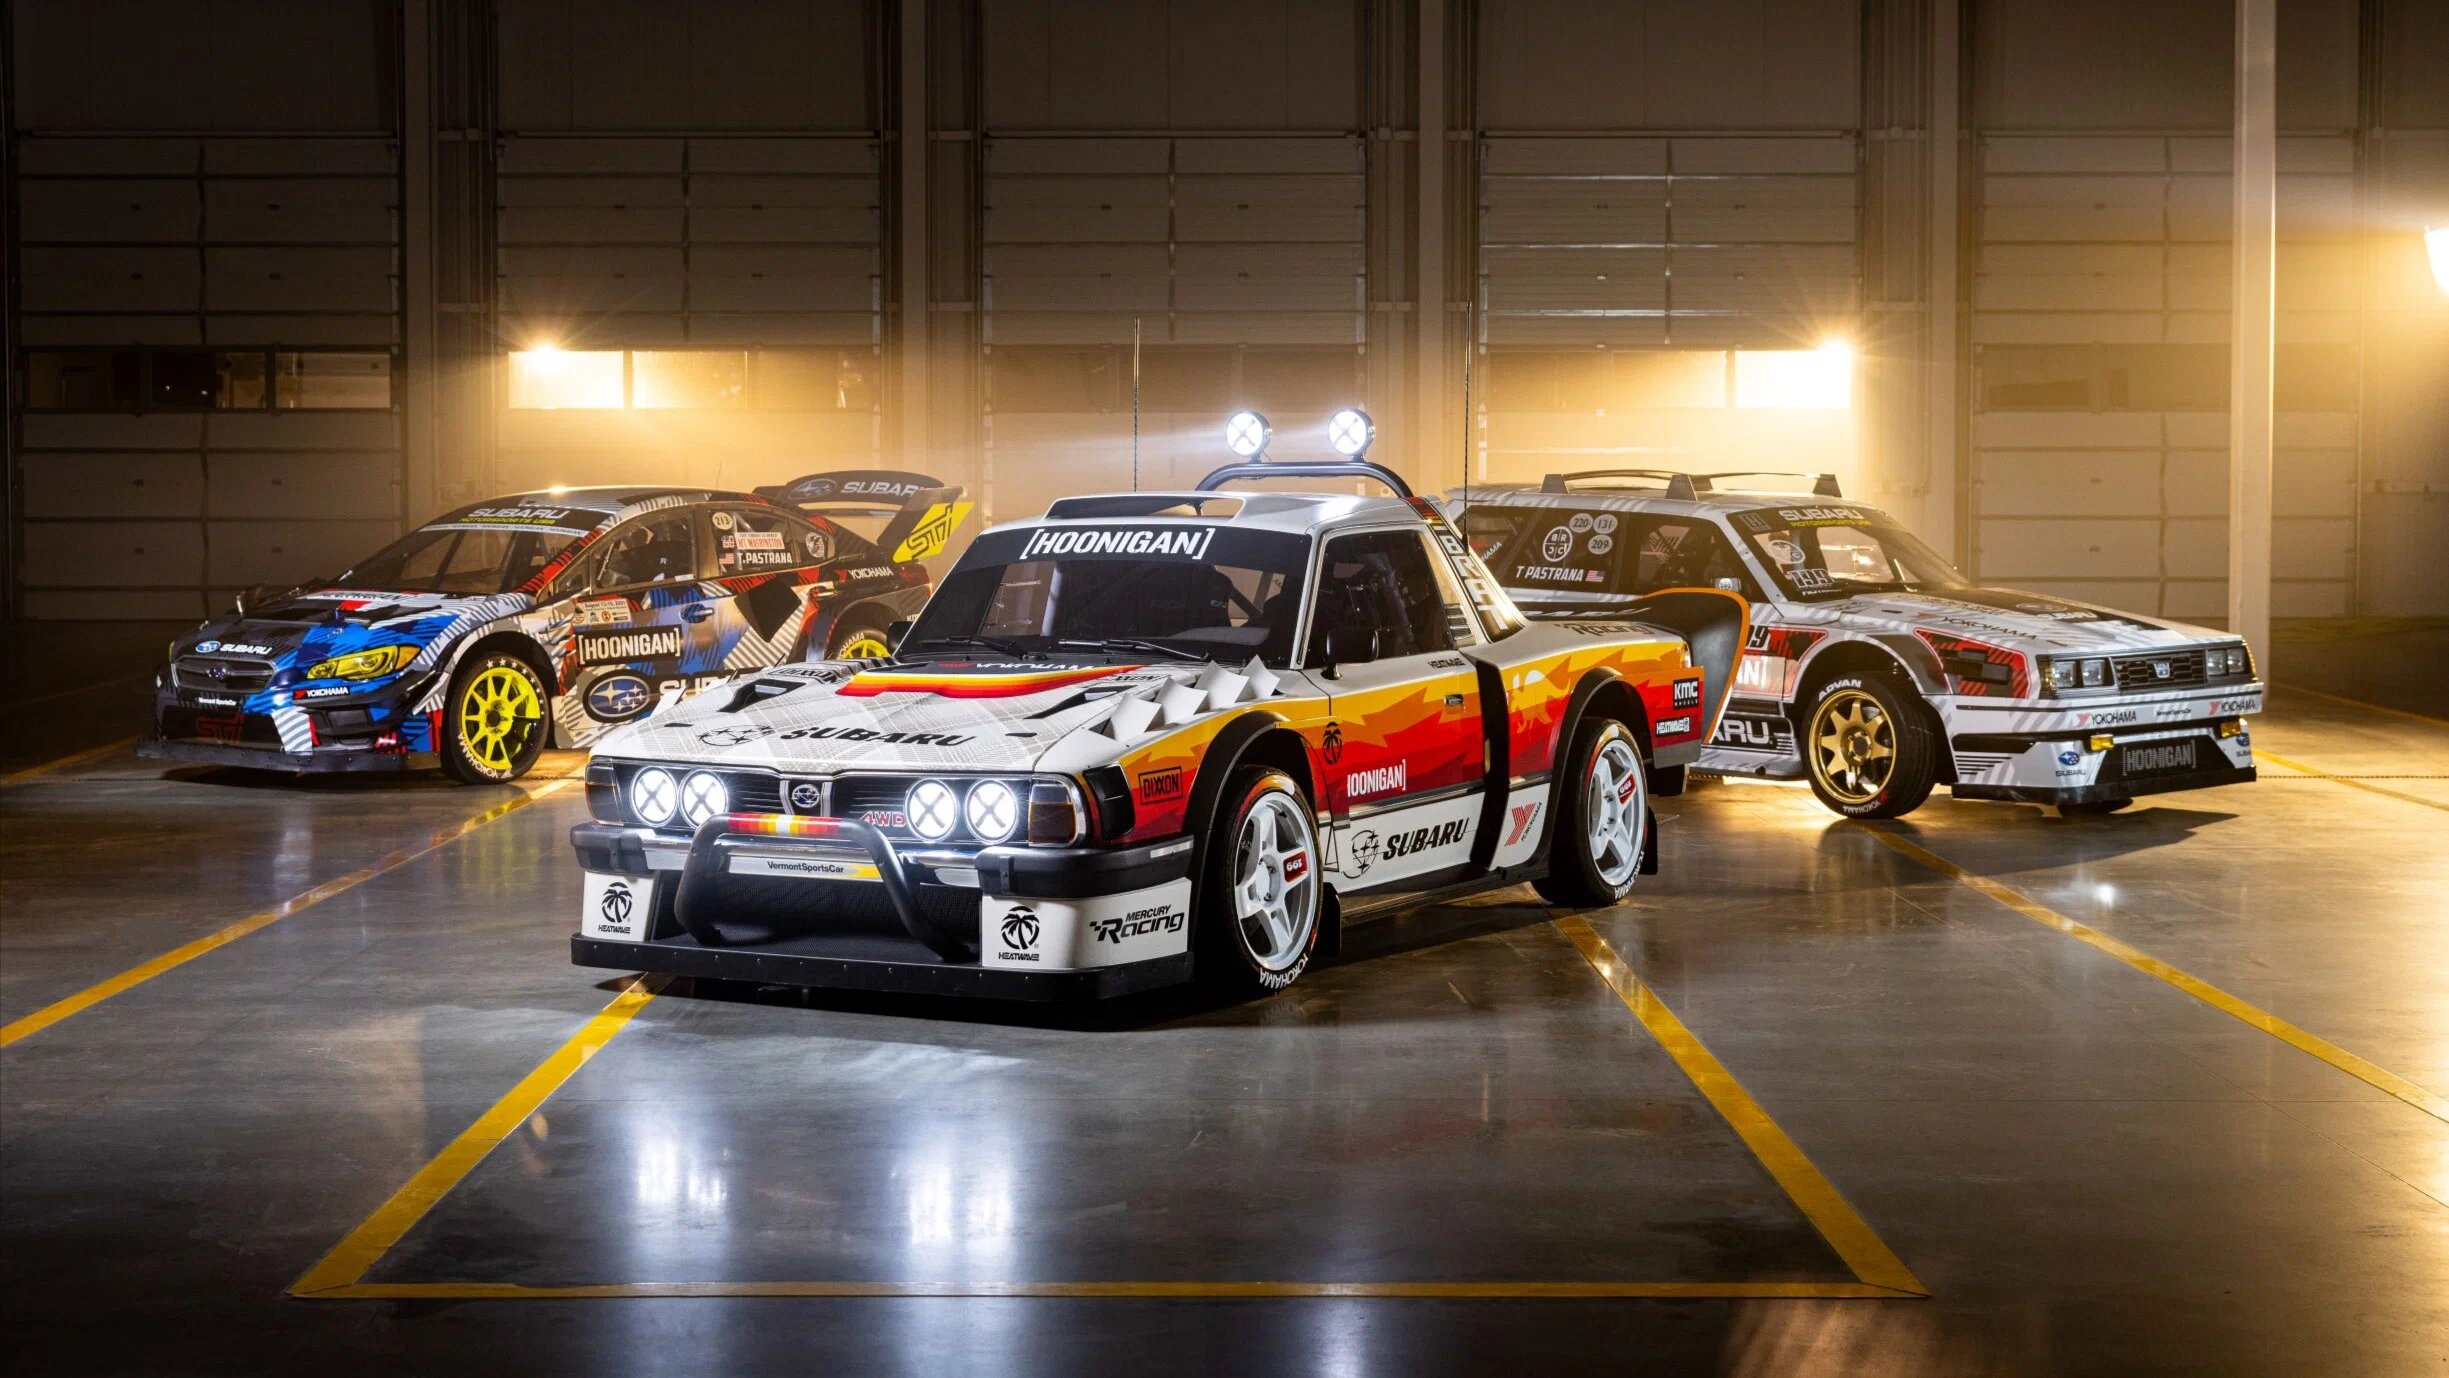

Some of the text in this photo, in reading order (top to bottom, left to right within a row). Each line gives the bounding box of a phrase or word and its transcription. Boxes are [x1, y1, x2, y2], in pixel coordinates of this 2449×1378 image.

[841, 481, 919, 497] SUBAR
[468, 508, 571, 519] SUBARU
[1778, 509, 1864, 520] SUBARU
[906, 503, 953, 560] STI
[1573, 518, 1589, 528] 220
[1598, 519, 1613, 529] 131
[1019, 528, 1216, 560] [HOONIGAN]
[1483, 541, 1502, 561] HAMA
[1592, 540, 1609, 549] 209
[848, 566, 894, 580] YOKOHAMA
[1516, 566, 1584, 582] T PASTRANA
[1786, 568, 1835, 588] 199
[1438, 534, 1508, 631] BRAT
[220, 643, 273, 655] SUBARU
[578, 627, 681, 665] [HOONIGAN]
[306, 687, 349, 697] YOKOHAMA
[1674, 681, 1698, 700] KMC
[1818, 679, 1862, 701] ADVAN
[2220, 699, 2256, 713] YOKOHAMA
[2091, 710, 2137, 725] YOKOHAMA
[780, 727, 977, 746] SUBARU
[1712, 719, 1770, 744] ARU
[458, 732, 498, 779] YOKOHAMA
[2121, 740, 2197, 776] [HOONIGAN]
[1347, 759, 1407, 798] OONIGAN]
[2055, 769, 2087, 777] SUBARU
[1143, 773, 1179, 798] DIXXON
[1842, 800, 1881, 815] YOKOHAMA
[860, 811, 906, 828] 4WD
[1382, 817, 1470, 861] SUBARU
[767, 860, 845, 874] VermontSportsCar
[1286, 857, 1302, 872] 199
[1125, 904, 1171, 923] MERCURY
[598, 924, 631, 934] HEATWAVE
[1096, 911, 1185, 944] Racing
[998, 951, 1040, 962] HEATWAVE
[1259, 952, 1309, 989] YOKOHAMA
